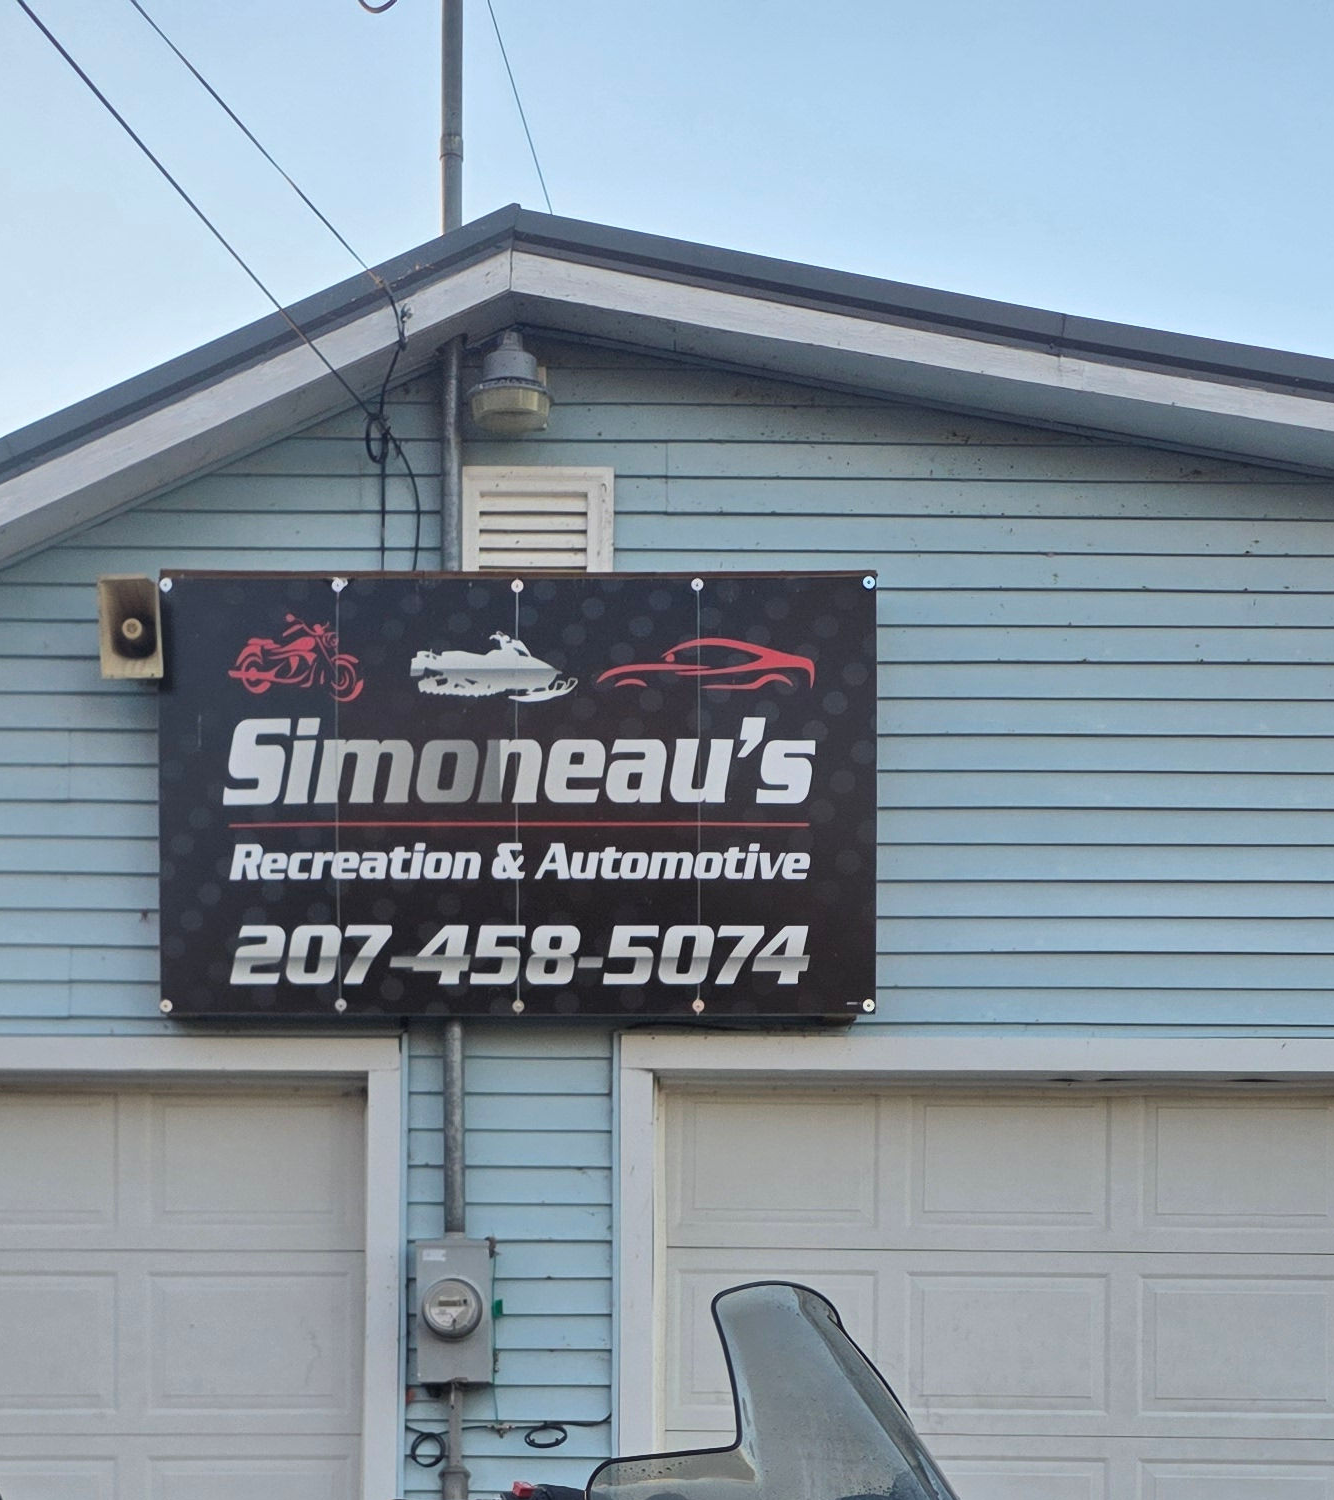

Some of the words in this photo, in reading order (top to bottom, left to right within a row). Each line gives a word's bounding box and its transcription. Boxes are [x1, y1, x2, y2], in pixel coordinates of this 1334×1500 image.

[223, 717, 816, 806] Simoneau's
[229, 842, 481, 881] Recreation
[491, 842, 526, 880] &
[535, 842, 811, 881] Automotive
[230, 924, 811, 986] 207-458-5074
